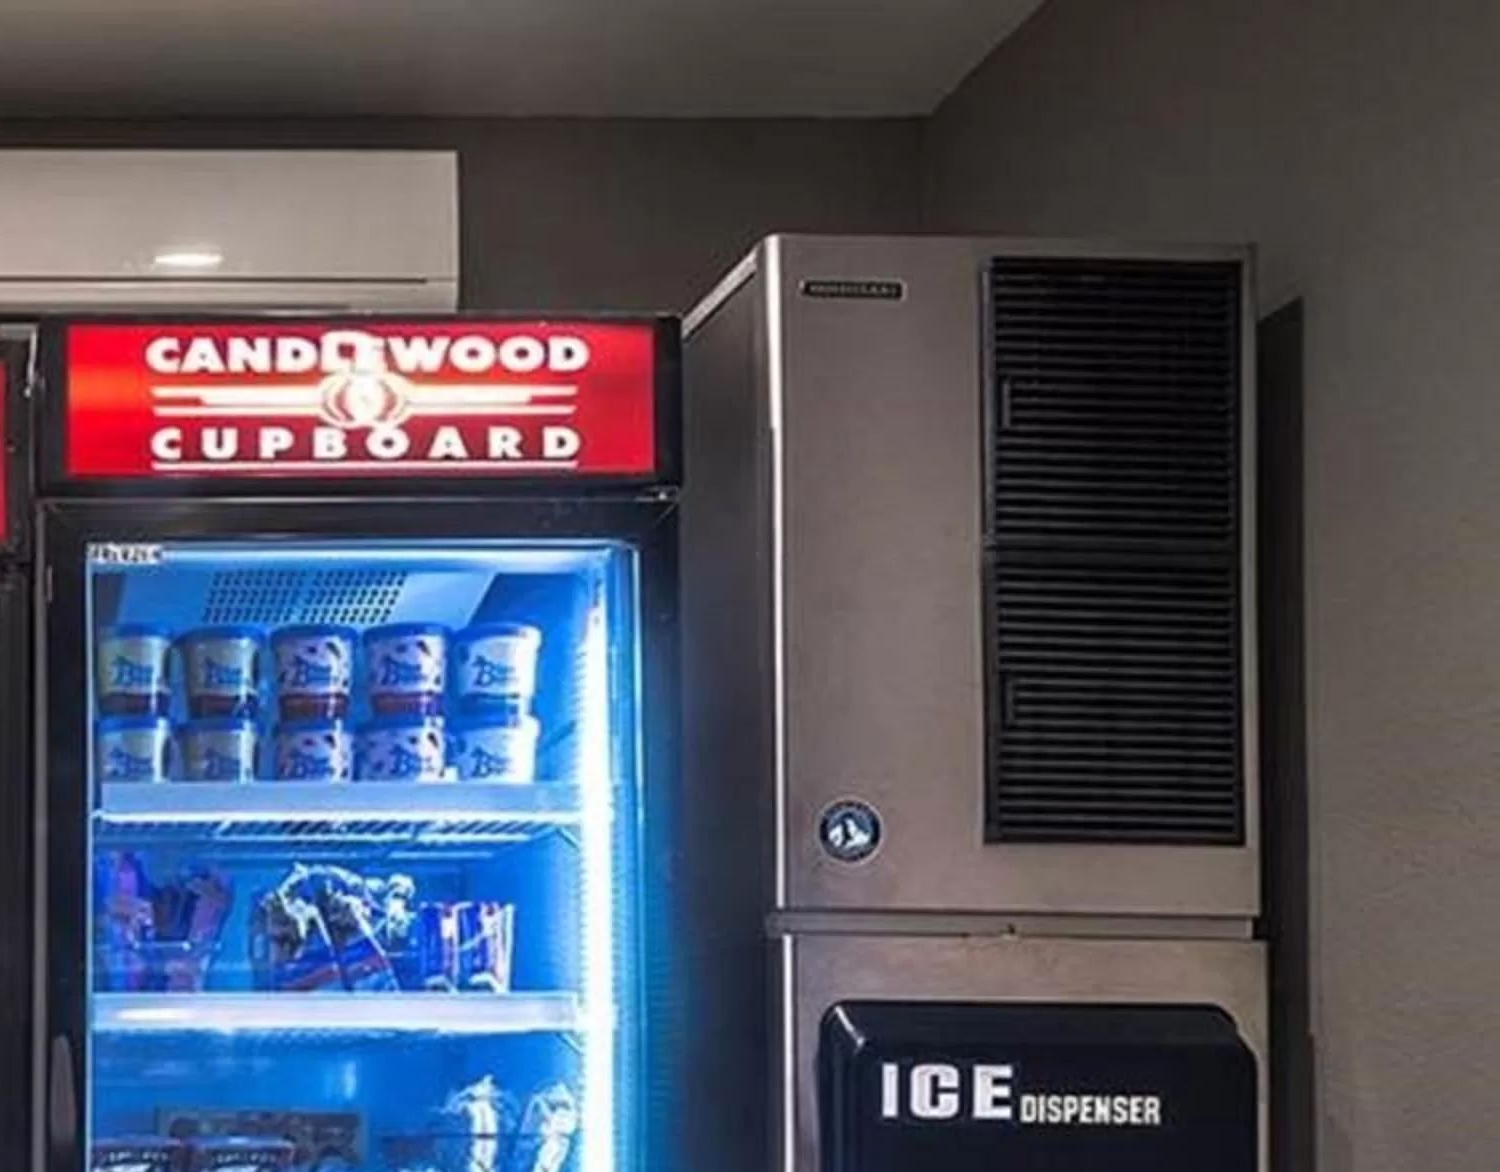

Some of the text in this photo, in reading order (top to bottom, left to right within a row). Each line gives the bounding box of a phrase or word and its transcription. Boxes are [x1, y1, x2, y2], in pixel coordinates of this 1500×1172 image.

[145, 330, 589, 373] CANDLEWOOD
[151, 425, 582, 461] CUPBOARD
[881, 1062, 1162, 1126] ICE DISPENSER
